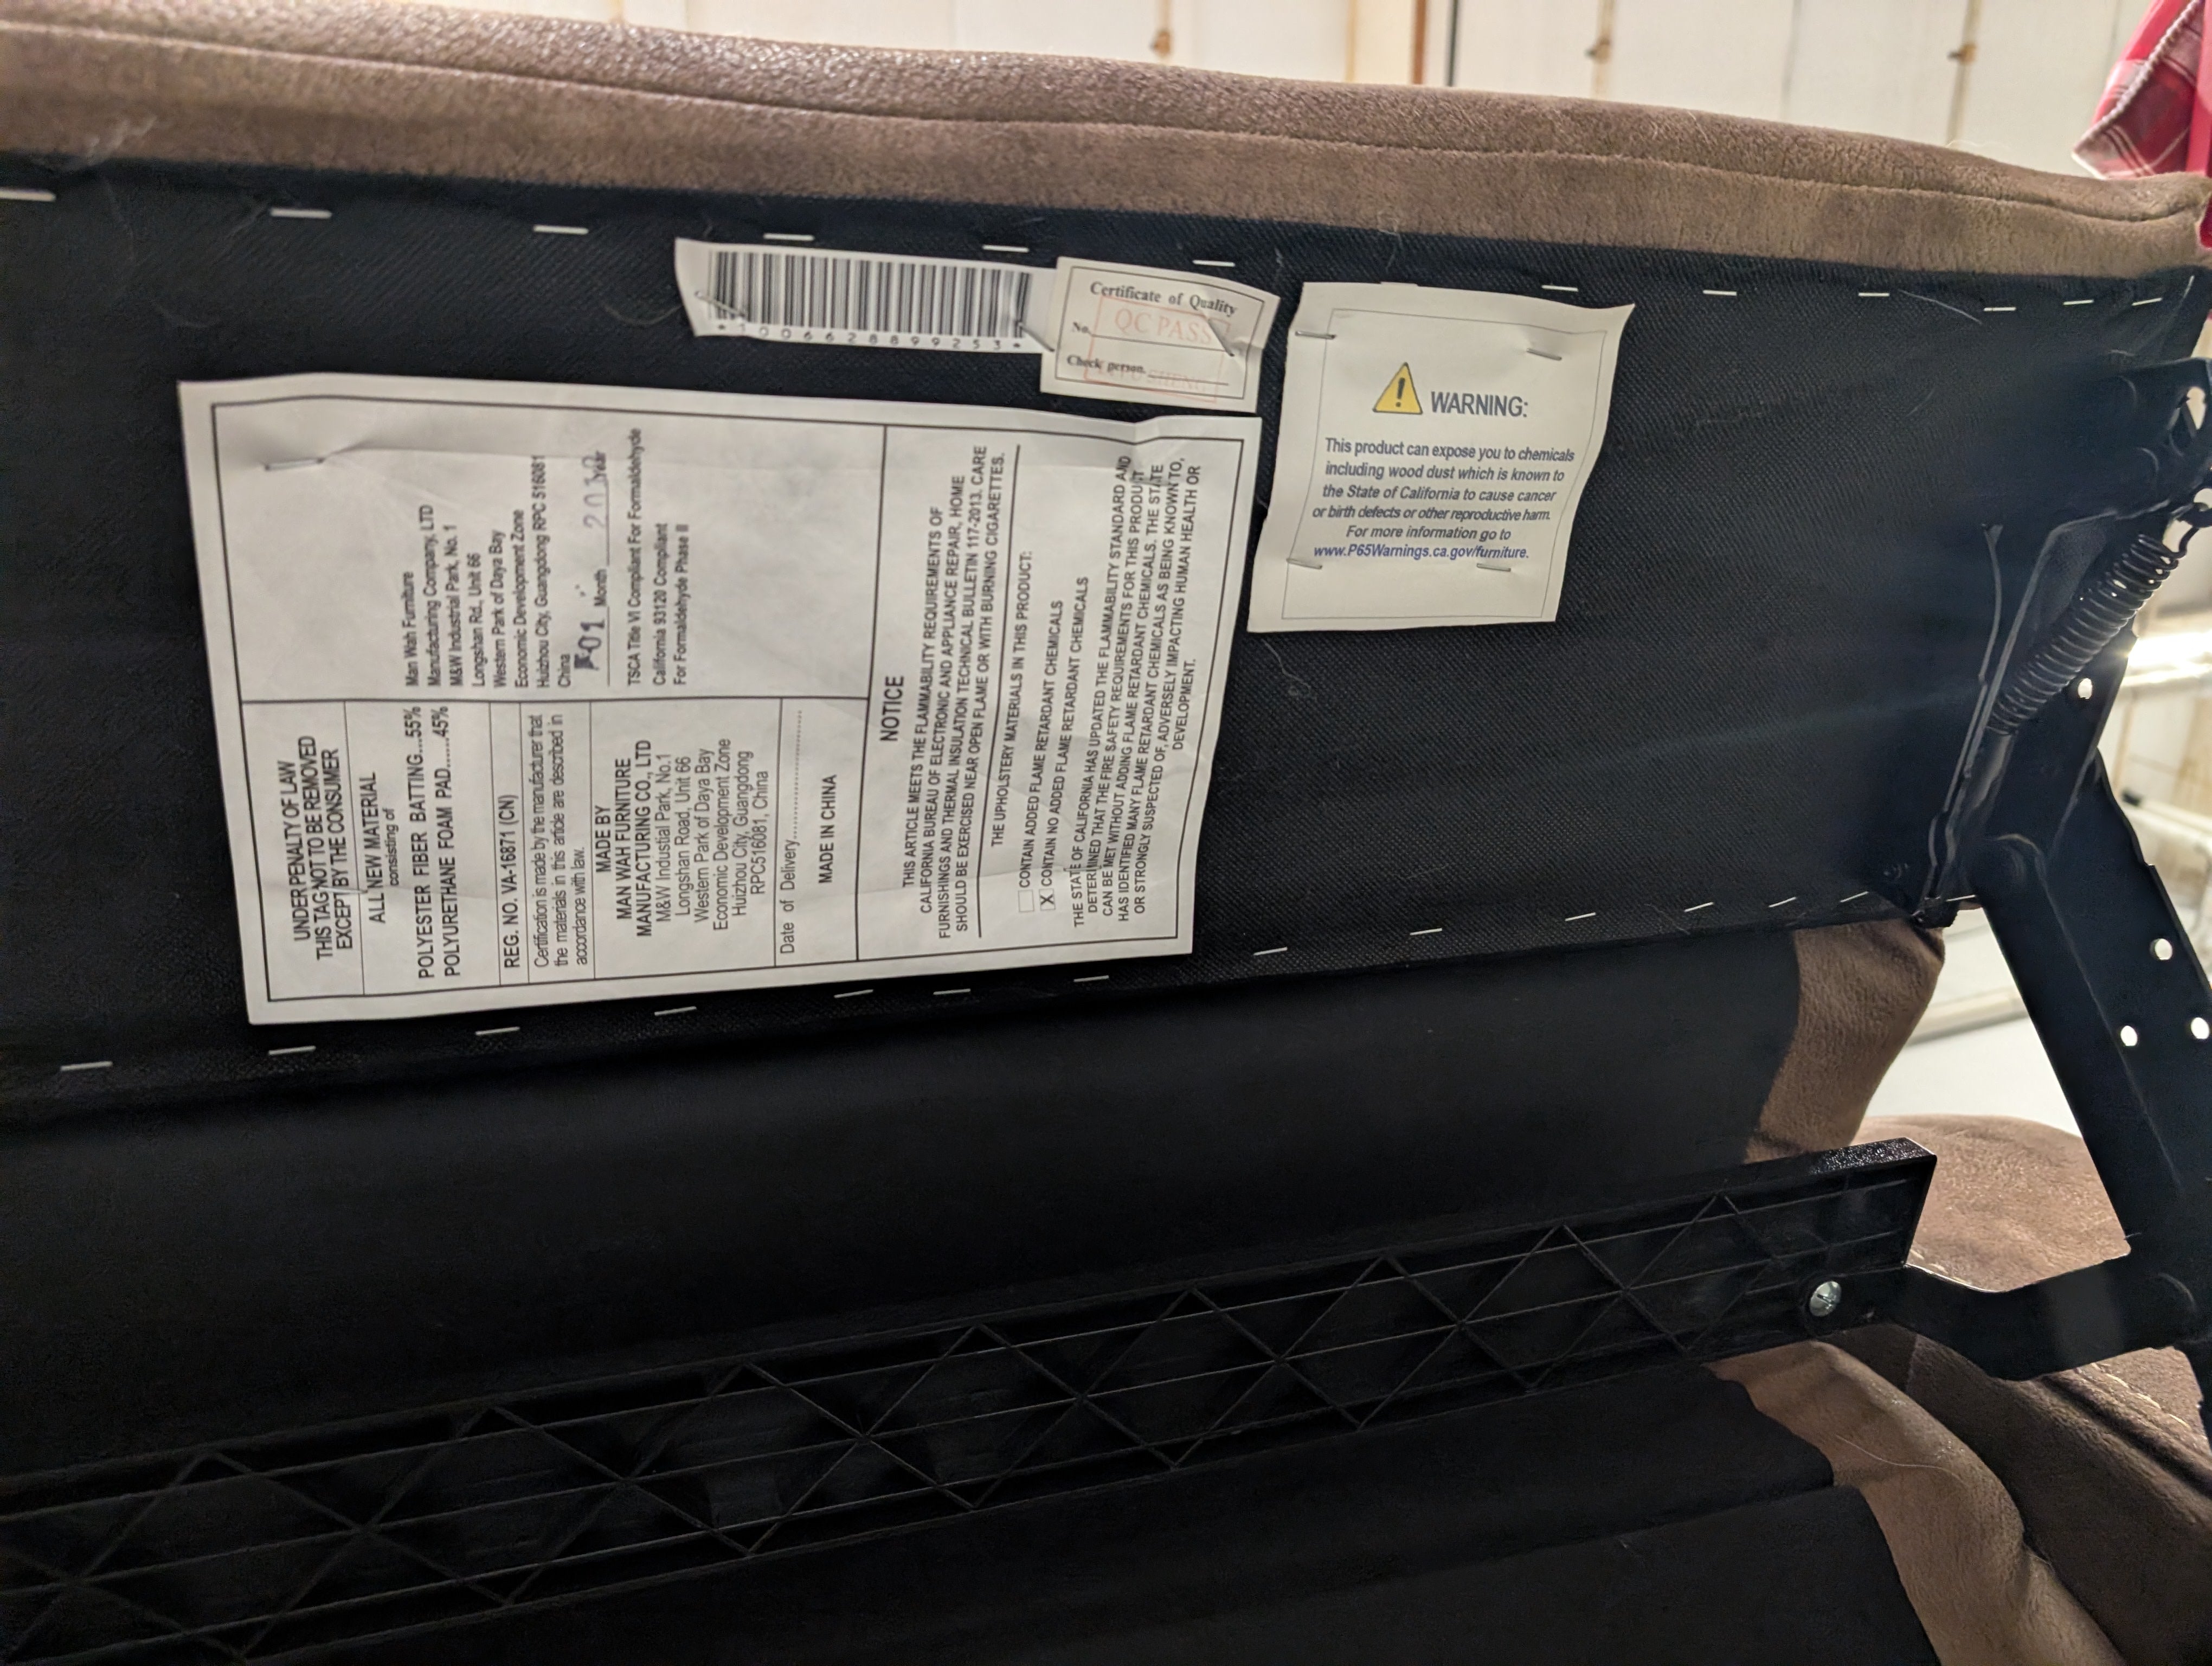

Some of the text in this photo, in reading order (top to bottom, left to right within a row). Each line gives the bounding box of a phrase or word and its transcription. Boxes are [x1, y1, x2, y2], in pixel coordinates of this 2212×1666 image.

[1090, 281, 1237, 318] Certificate of Quality
[1115, 308, 1212, 344] QC PASS
[1066, 355, 1103, 370] Check
[1107, 362, 1146, 374] person.
[1431, 391, 1528, 418] WARNING:
[1325, 437, 1576, 462] This product can expose you to chemicals
[1325, 460, 1565, 482] including wood dust which is known to
[532, 503, 547, 531] RPC
[1312, 504, 1551, 523] or birth defects or other reproductive harm.
[1322, 484, 1558, 502] the State of California to cause cancer
[466, 553, 481, 568] 66
[653, 523, 670, 587] Compliant
[1314, 543, 1529, 561] www.P65Warnings.ca.gov/furniture.
[1345, 524, 1512, 543] For more information go to
[467, 571, 483, 597] Unit
[533, 534, 551, 608] Guangdong
[400, 571, 419, 687] Man Wah Furniture
[535, 610, 551, 637] City,
[1069, 576, 1089, 653] CHEMICALS
[470, 627, 487, 687] Longshan
[536, 639, 550, 688] Huizhou
[557, 653, 572, 689] China
[652, 627, 667, 686] California
[879, 676, 905, 742] NOTICE
[902, 507, 943, 888] THIS ARTICLE MEETS THE FLAMMABILITY REQUIREMENTS OF
[990, 552, 1032, 848] THE UPHOLSTERY MATERIALS IN THIS PRODUCT:
[1060, 656, 1081, 732] RETARDANT
[1018, 600, 1064, 888] CONTAIN ADDED FLAME RETARDANT CHEMICALS
[1054, 734, 1072, 773] FLAME
[435, 806, 455, 849] FOAM
[1046, 817, 1059, 835] NO
[1049, 776, 1065, 815] ADDED
[277, 760, 311, 941] UNDER PENALTY OF LAW
[298, 736, 333, 961] THIS TAG NOT TO BE REMOVED
[320, 748, 353, 950] EXCEPT BY THE CONSUMER
[359, 772, 386, 924] ALL NEW MATERIAL
[382, 808, 400, 887] consisting of
[410, 832, 430, 876] FIBER
[594, 805, 612, 873] MADE BY
[614, 758, 632, 920] MAN WAH FURNITURE
[634, 740, 653, 937] MANUFACTURING CO., LTD
[654, 754, 673, 922] M&W Industial Park, No.1
[674, 756, 695, 916] Longshan Road, Unit 66
[693, 748, 715, 924] Western Park of Daya Bay
[712, 738, 734, 932] Economic Development Zone
[731, 751, 754, 917] Huizhou City, Guangdong
[749, 771, 770, 895] RPC516081, China
[818, 774, 837, 884] MADE IN CHINA
[498, 794, 520, 969] REG. NO. VA-16871 (CN)
[1040, 837, 1057, 887] CONTAIN
[414, 885, 435, 979] POLYESTER
[438, 856, 461, 977] POLYURETHANE
[779, 899, 795, 913] of
[779, 922, 795, 954] Date
